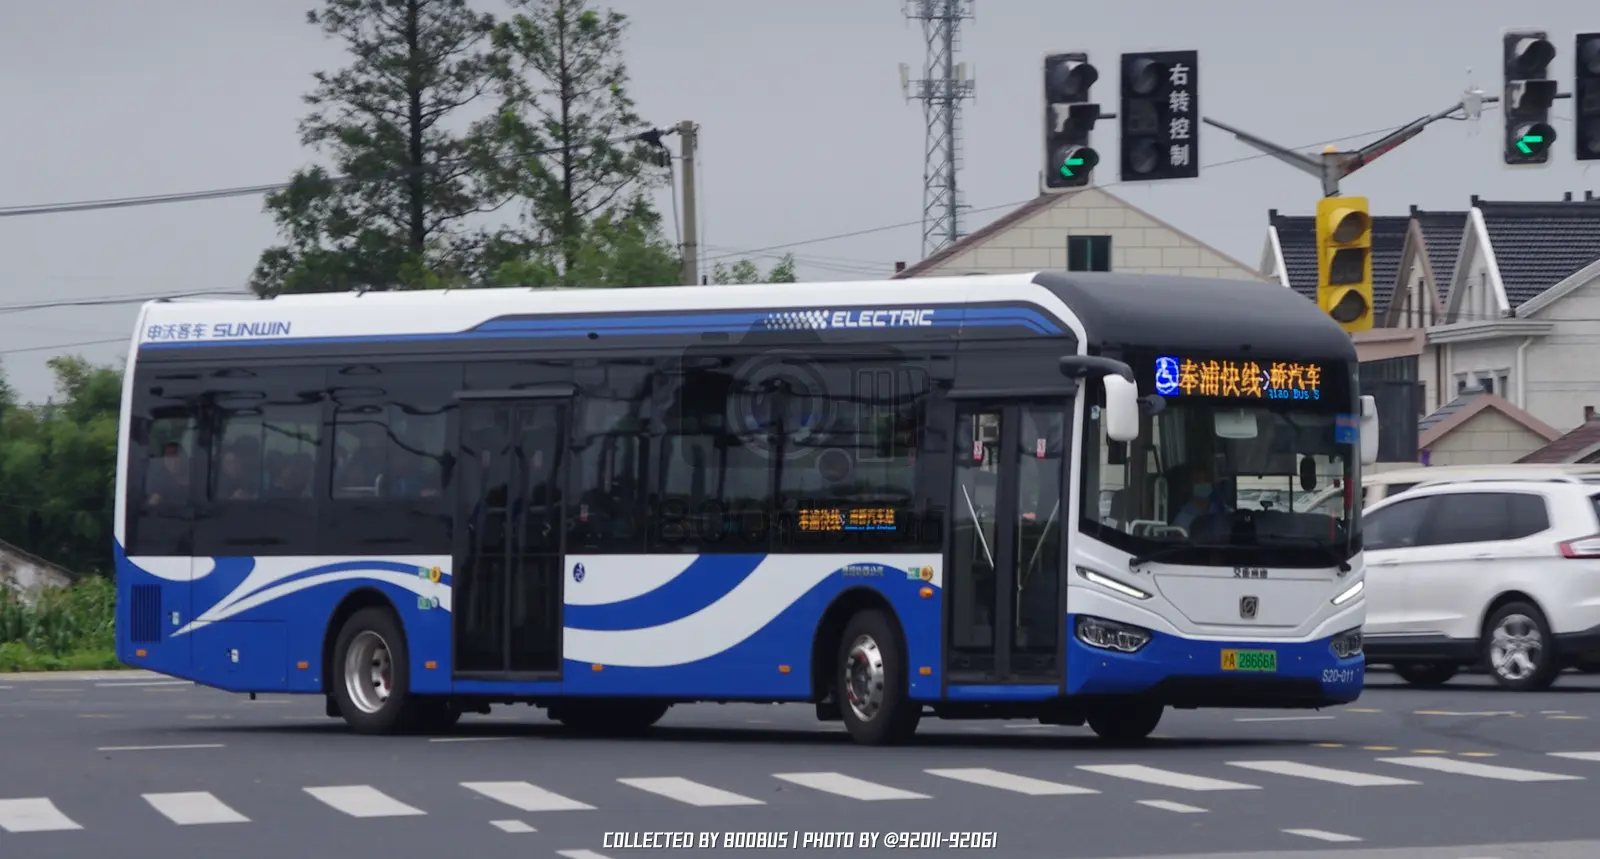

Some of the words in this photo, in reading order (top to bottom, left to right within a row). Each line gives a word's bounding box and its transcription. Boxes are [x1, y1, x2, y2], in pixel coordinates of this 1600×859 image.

[1168, 62, 1190, 167] 右转控制
[212, 321, 291, 338] SUNWIN
[831, 308, 935, 327] ELECTRIC
[147, 323, 207, 340] 申沃客车
[1180, 358, 1262, 398] 奉浦快线
[1269, 361, 1321, 391] 桥汽车
